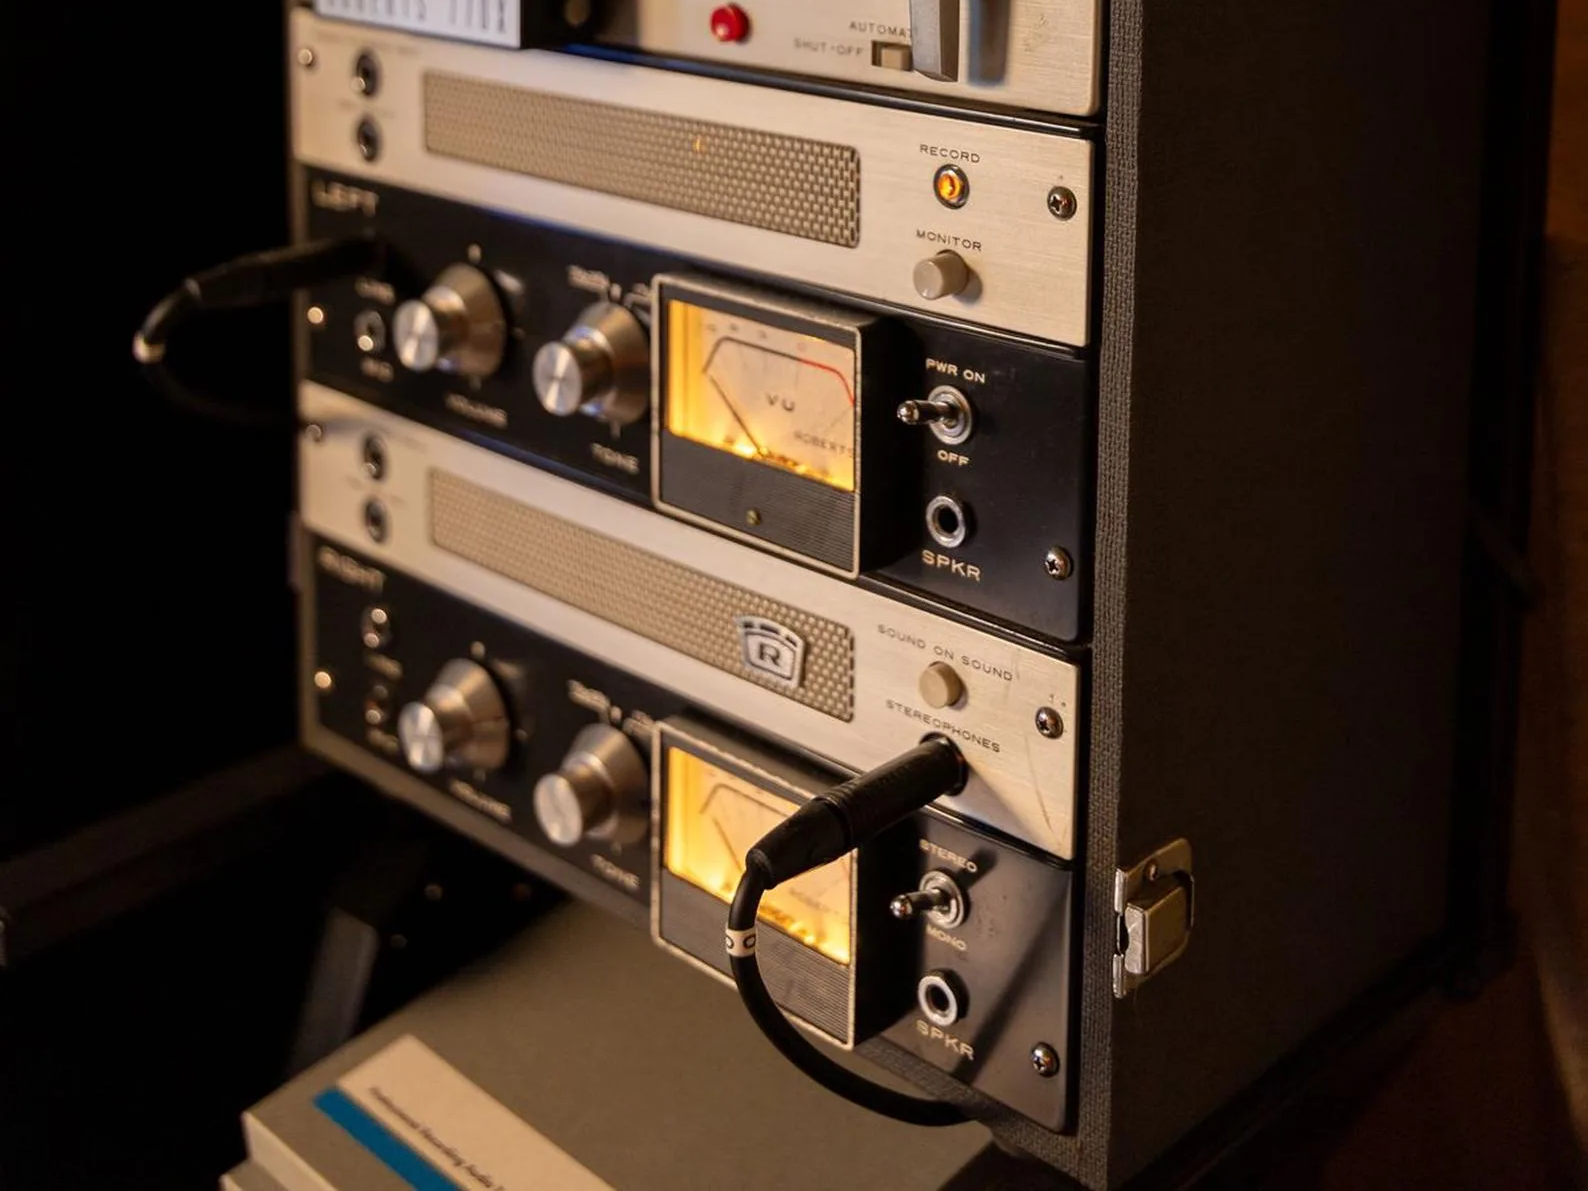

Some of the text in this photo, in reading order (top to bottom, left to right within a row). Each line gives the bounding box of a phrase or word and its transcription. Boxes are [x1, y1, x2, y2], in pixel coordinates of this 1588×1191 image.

[848, 21, 913, 39] AUTOMA
[920, 144, 981, 164] RECORD
[915, 229, 982, 252] MONITOR
[926, 358, 986, 385] PWR ON
[936, 449, 970, 467] OFF
[921, 549, 982, 583] SPKR
[758, 642, 782, 669] R
[877, 623, 1014, 682] SOUND ON SOUND
[886, 698, 1001, 753] STEREOPHONES
[919, 838, 978, 874] STEREO
[925, 924, 968, 952] MONO
[915, 1019, 975, 1061] SPKR
